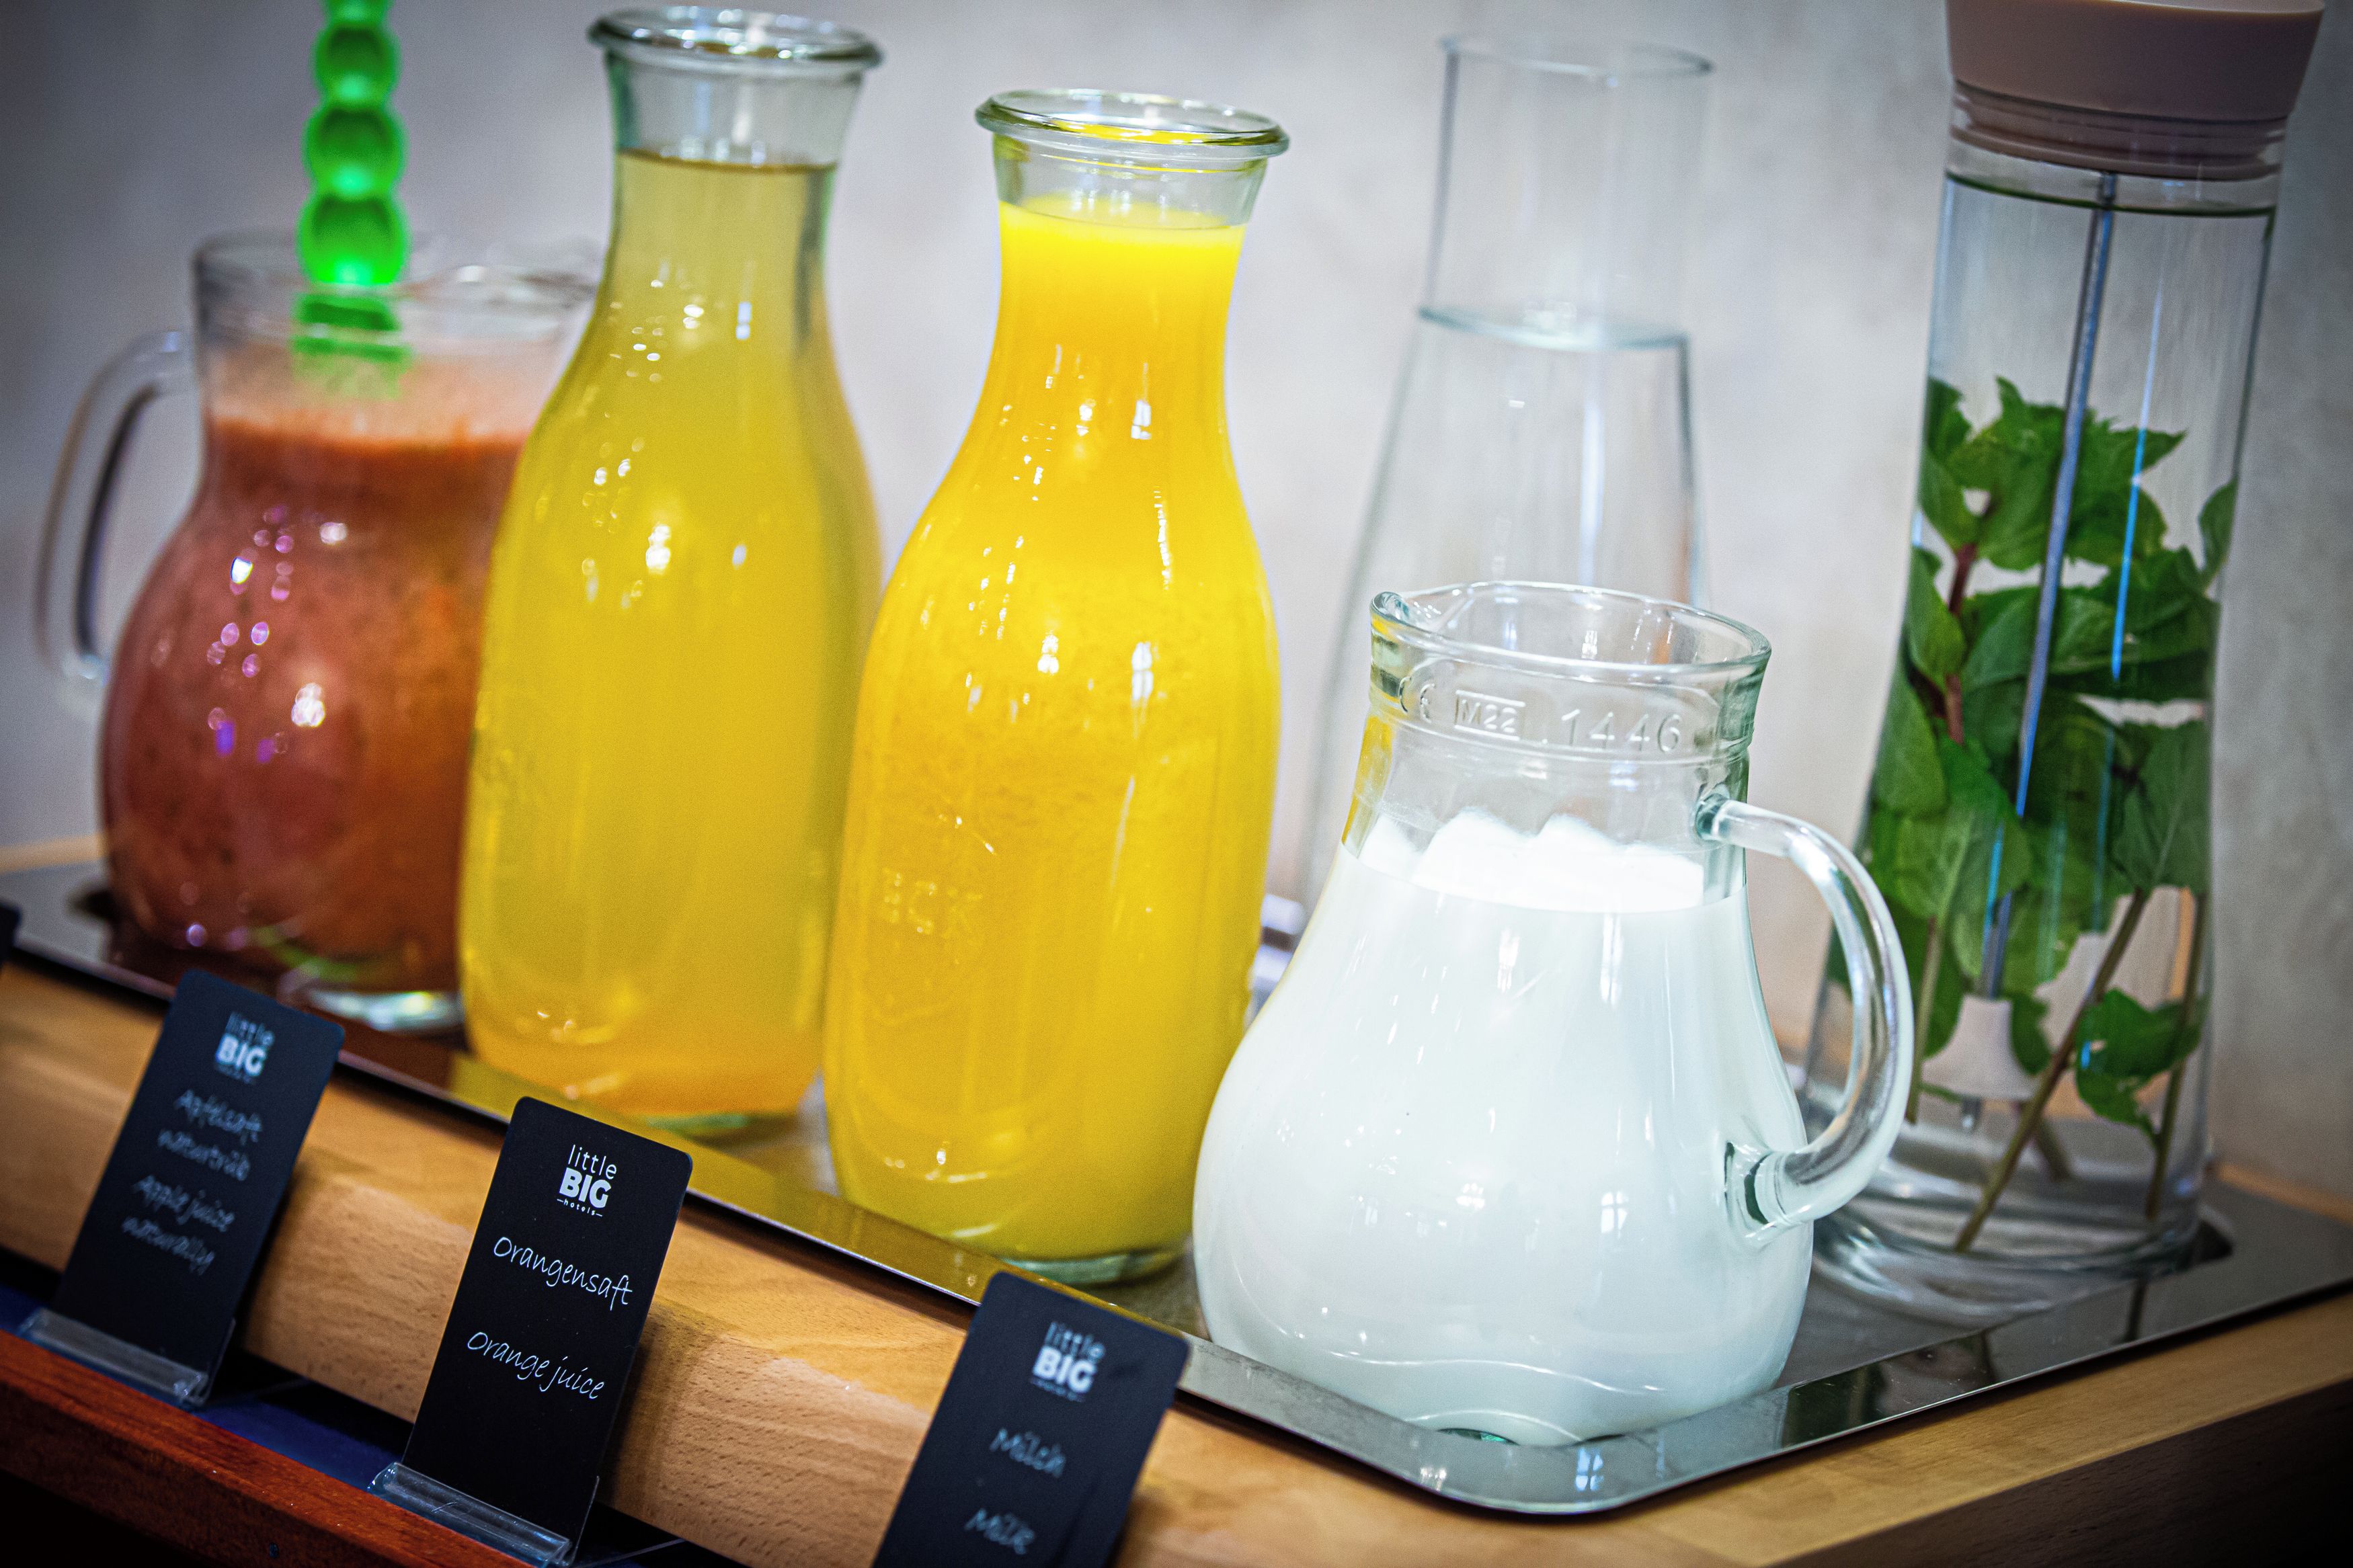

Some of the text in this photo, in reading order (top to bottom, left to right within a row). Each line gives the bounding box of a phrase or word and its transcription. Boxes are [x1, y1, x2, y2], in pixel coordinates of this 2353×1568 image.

[1460, 698, 1519, 734] M22
[216, 1034, 268, 1077] BIG
[568, 1144, 617, 1180] little
[559, 1167, 612, 1209] BIG
[493, 1237, 633, 1311] Orangensaft
[1044, 1321, 1107, 1362] little
[467, 1331, 605, 1399] Orange juice
[1033, 1346, 1097, 1394] BIG
[989, 1428, 1066, 1479] Milch
